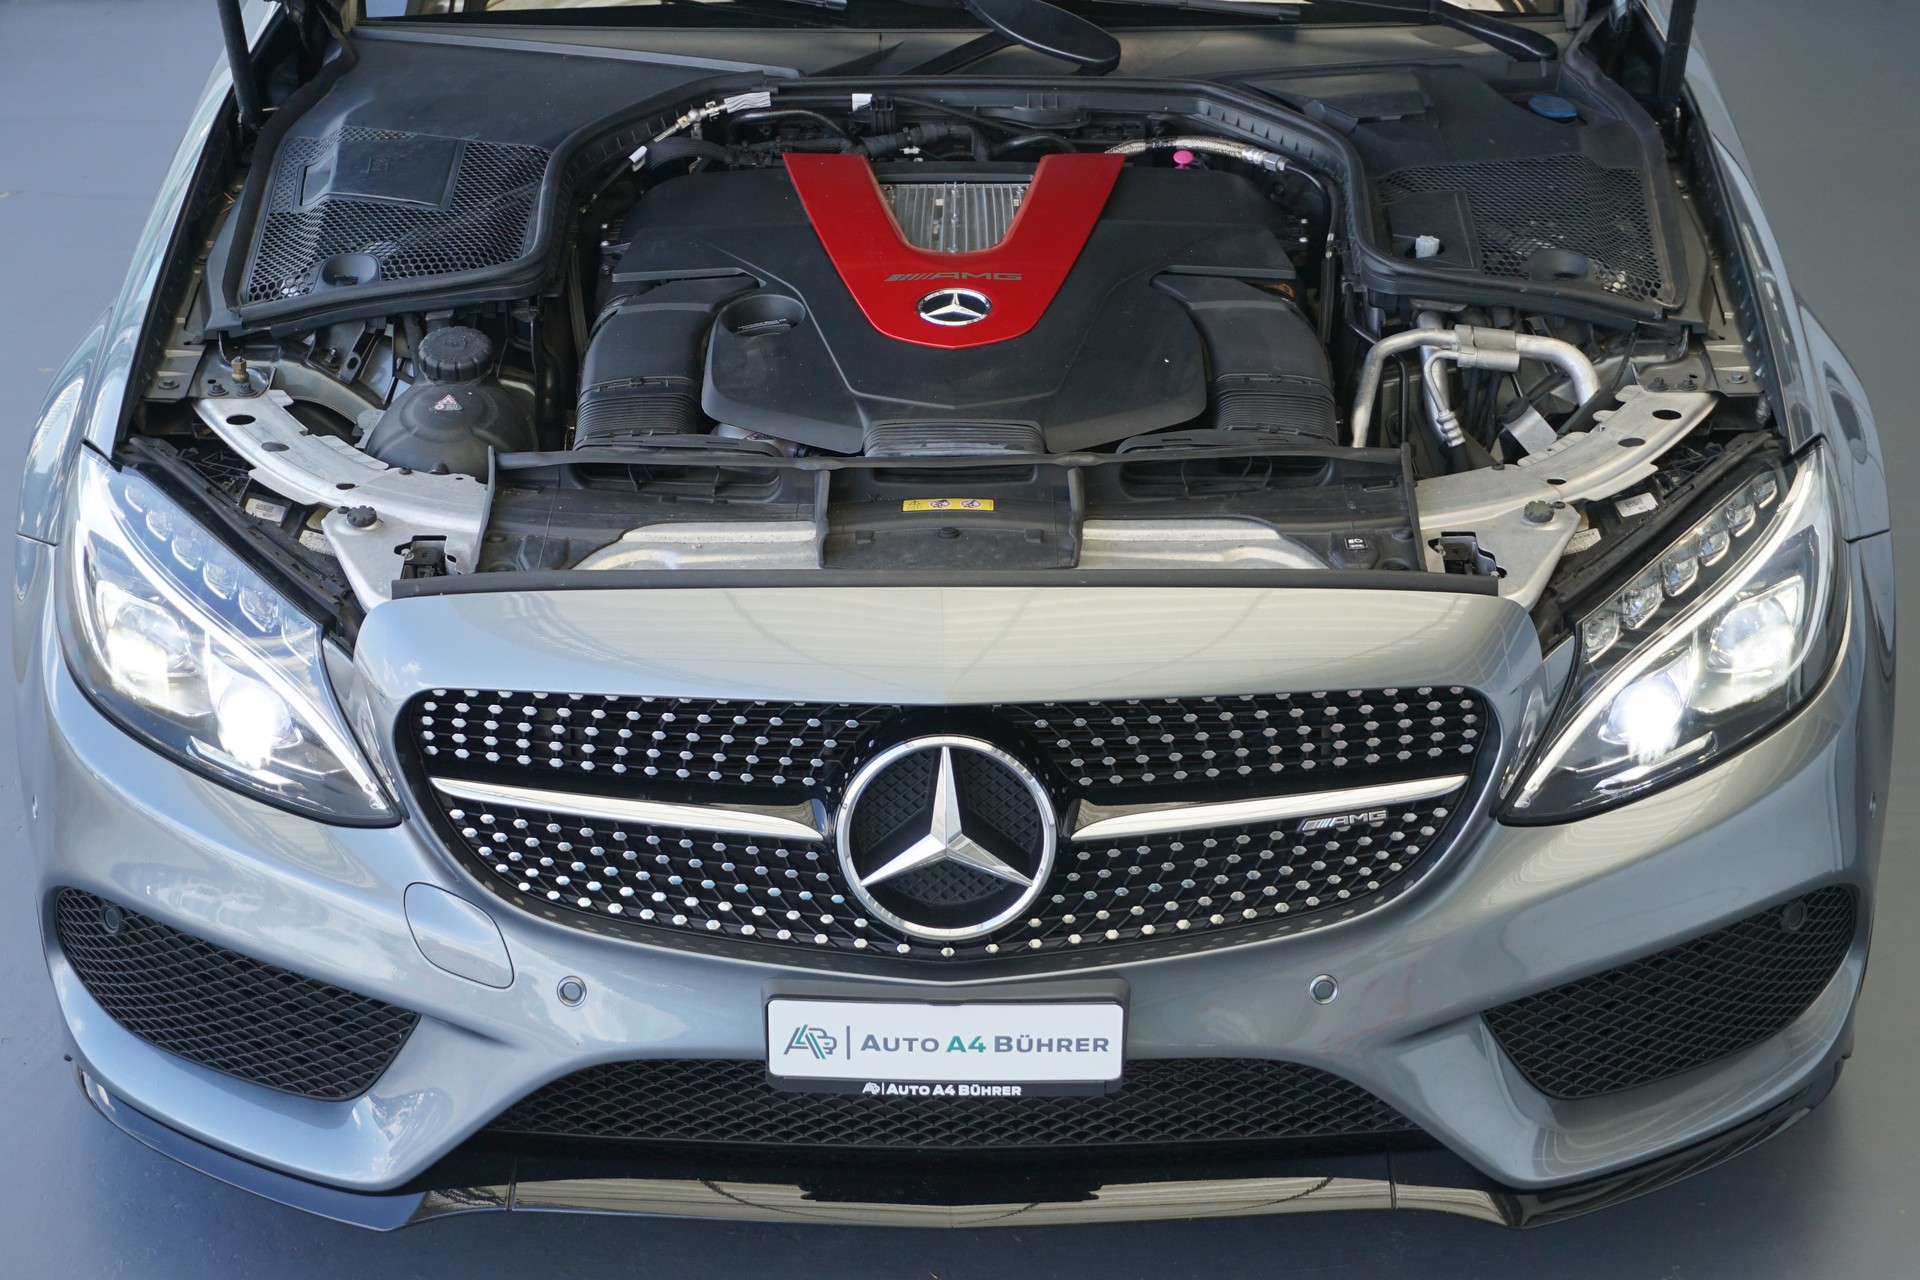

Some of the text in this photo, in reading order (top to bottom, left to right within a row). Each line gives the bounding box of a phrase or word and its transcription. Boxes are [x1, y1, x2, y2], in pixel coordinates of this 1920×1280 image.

[930, 271, 1022, 281] AMG
[1328, 809, 1388, 828] AMG
[860, 1034, 940, 1053] AUTO
[946, 1035, 987, 1053] A4
[994, 1034, 1110, 1053] BÜHRER
[886, 1083, 930, 1096] AUTO
[932, 1084, 956, 1096] A4
[958, 1084, 1022, 1097] BÜHRER
